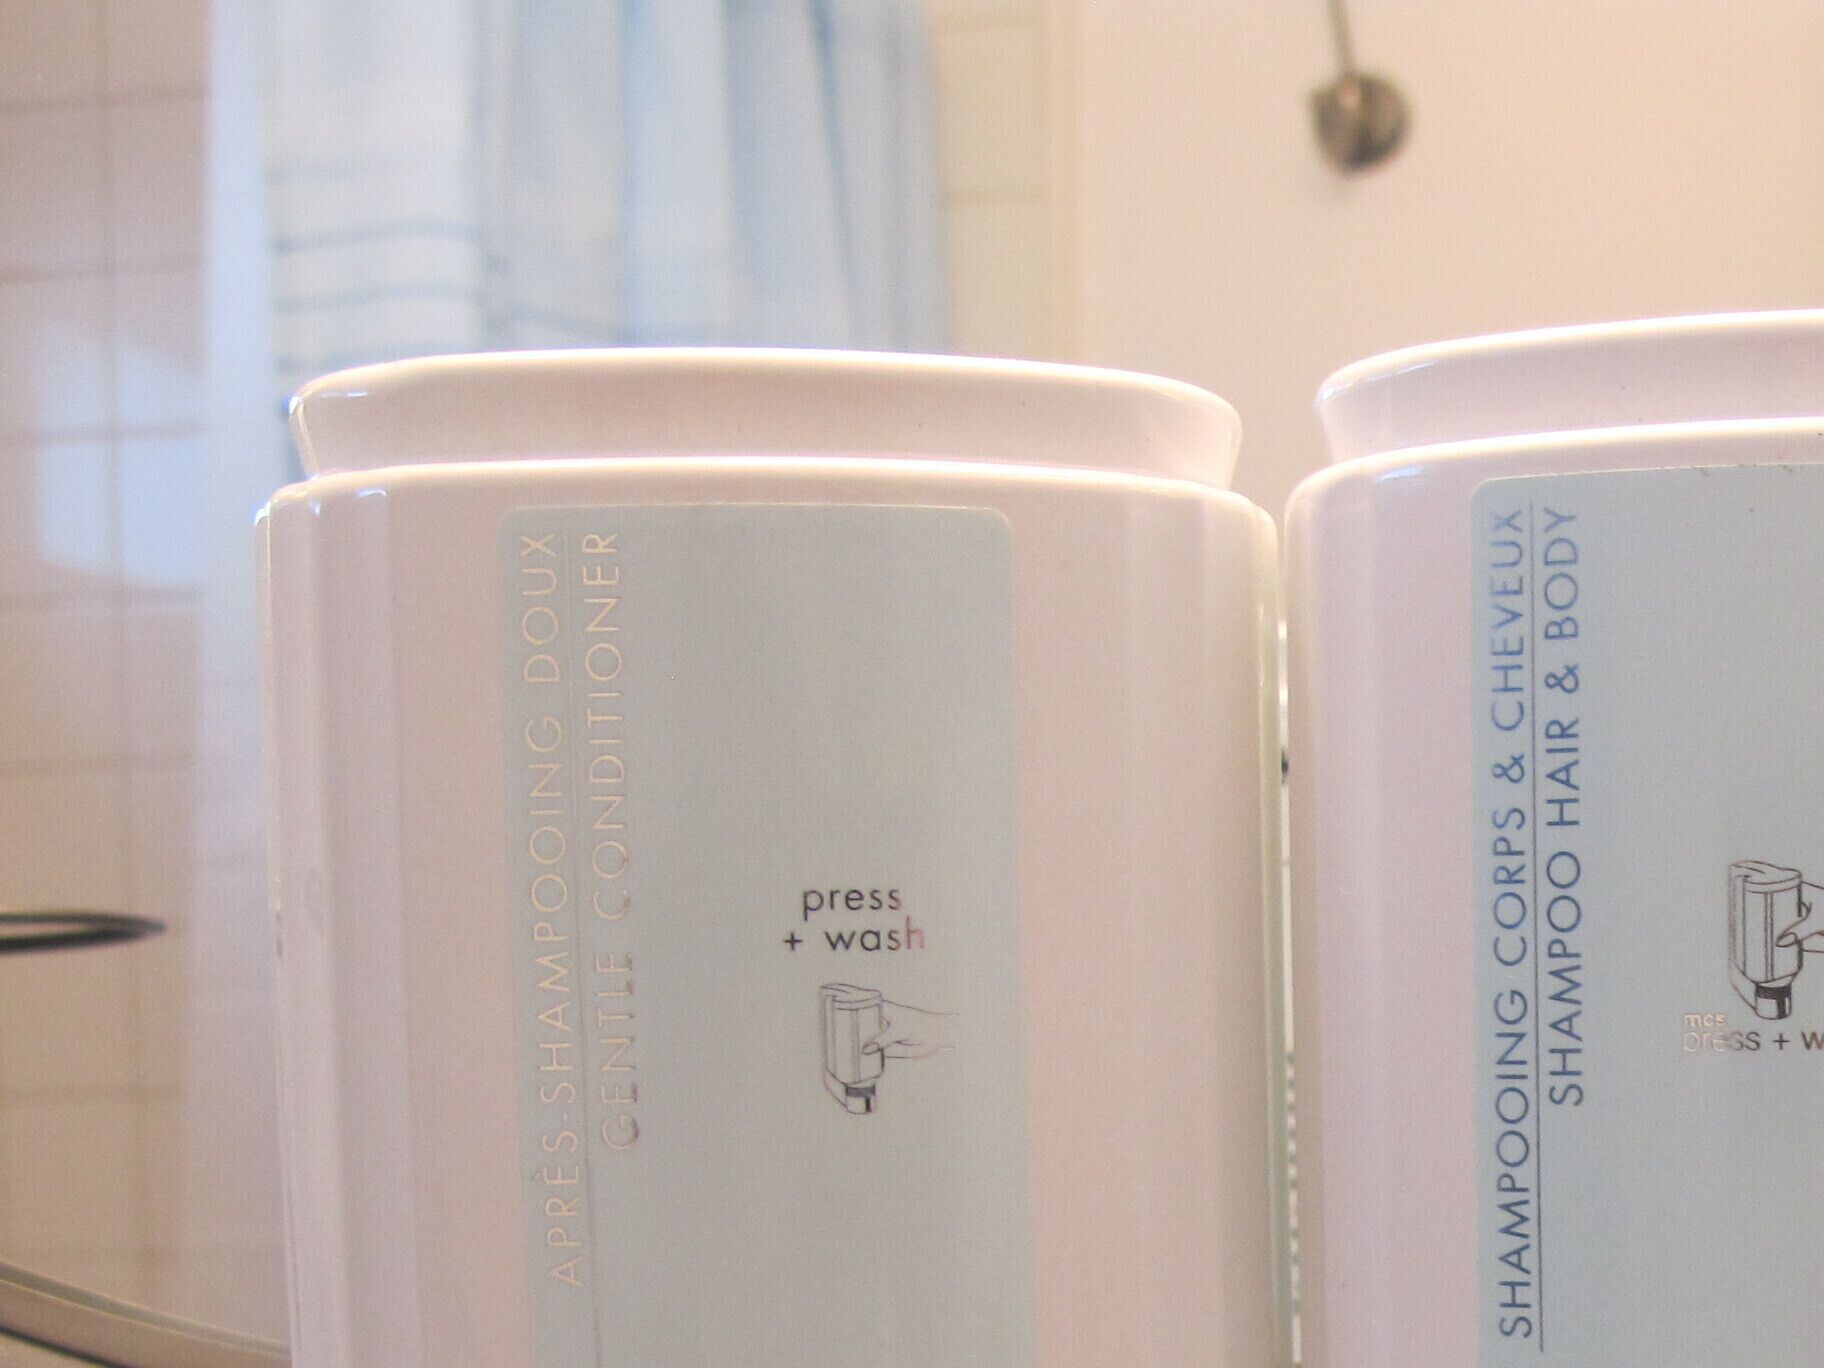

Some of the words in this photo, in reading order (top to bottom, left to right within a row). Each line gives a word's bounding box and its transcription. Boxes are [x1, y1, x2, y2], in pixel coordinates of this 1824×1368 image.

[520, 531, 562, 682] DOUX
[1489, 508, 1525, 732] CHEVEUX
[1544, 507, 1580, 640] BODY
[581, 531, 633, 922] CONDITIONER
[1545, 663, 1580, 692] &
[1492, 754, 1526, 783] &
[1546, 717, 1581, 827] HAIR
[802, 885, 902, 922] press
[825, 918, 926, 953] wash
[1493, 807, 1527, 966] CORPS
[526, 715, 582, 1288] APRÈS-SHAMPOOING
[594, 951, 640, 1152] GENTLE
[1547, 849, 1586, 1108] SHAMPOO
[1683, 1030, 1761, 1054] press
[1494, 989, 1532, 1339] SHAMPOOING
